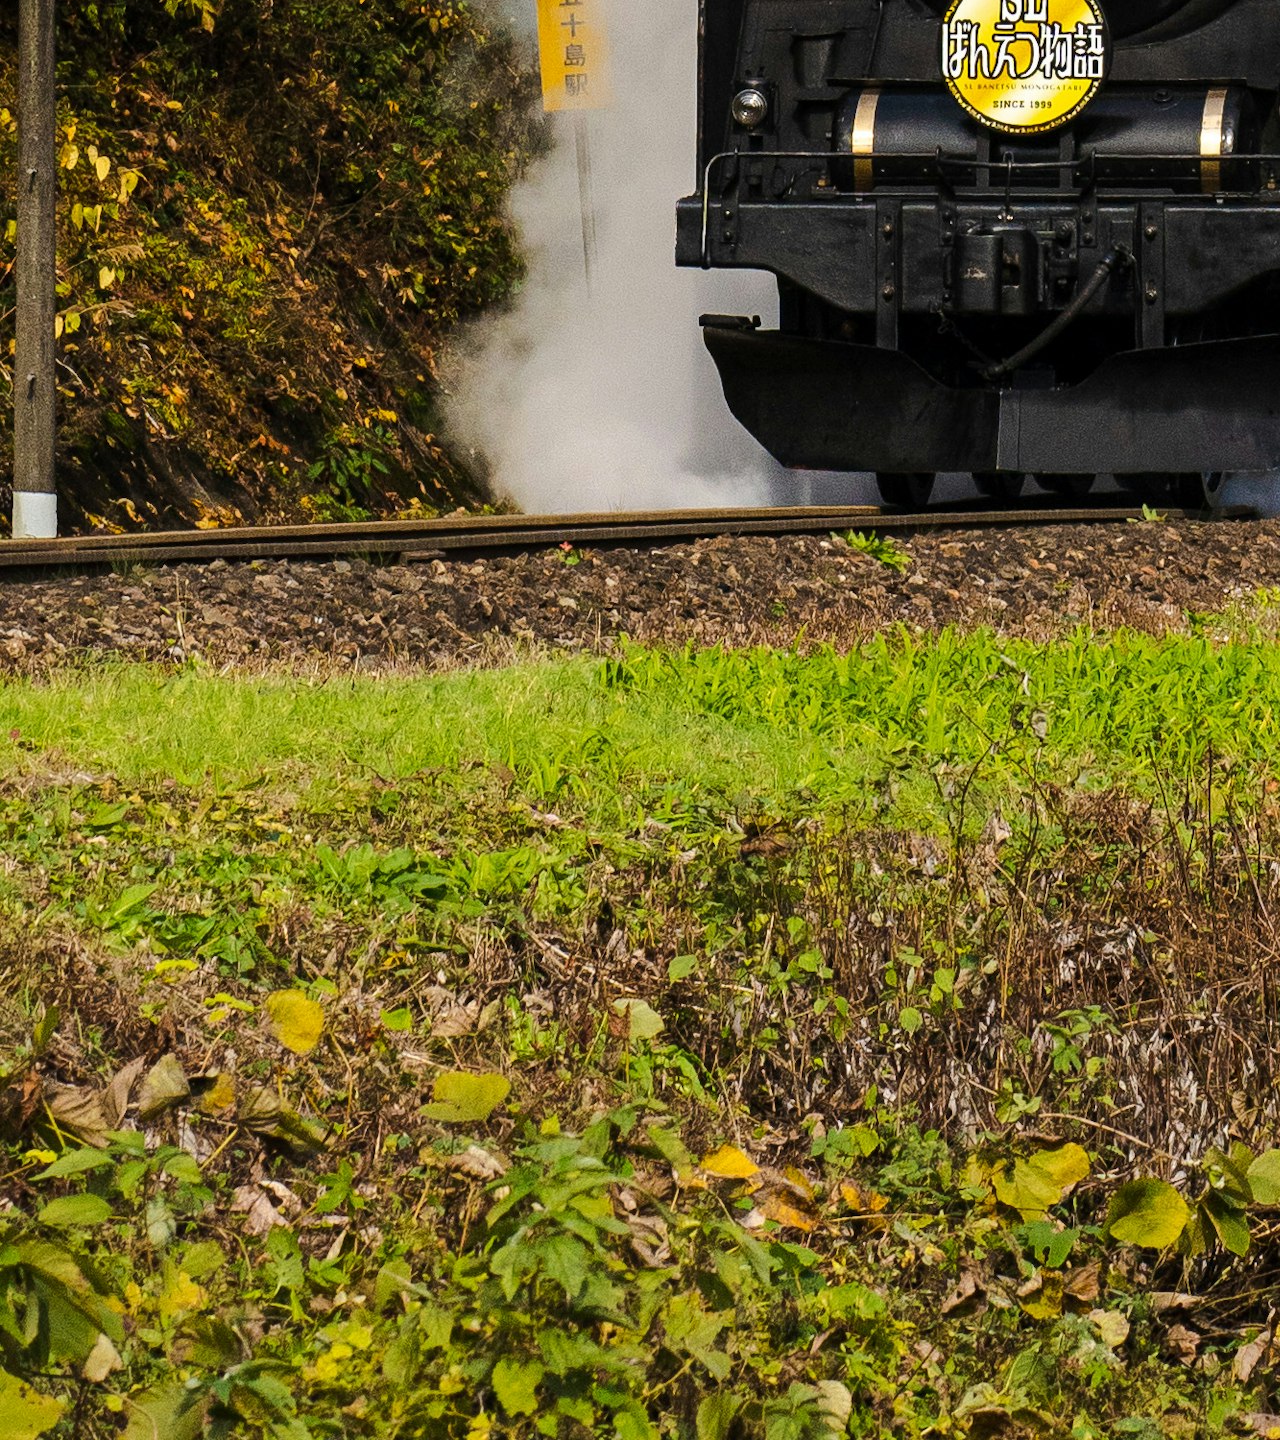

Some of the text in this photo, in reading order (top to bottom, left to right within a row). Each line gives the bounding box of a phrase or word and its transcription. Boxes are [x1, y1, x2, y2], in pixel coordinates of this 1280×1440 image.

[941, 21, 1104, 79] ばんえつ物語
[993, 100, 1052, 109] SINCE 1999
